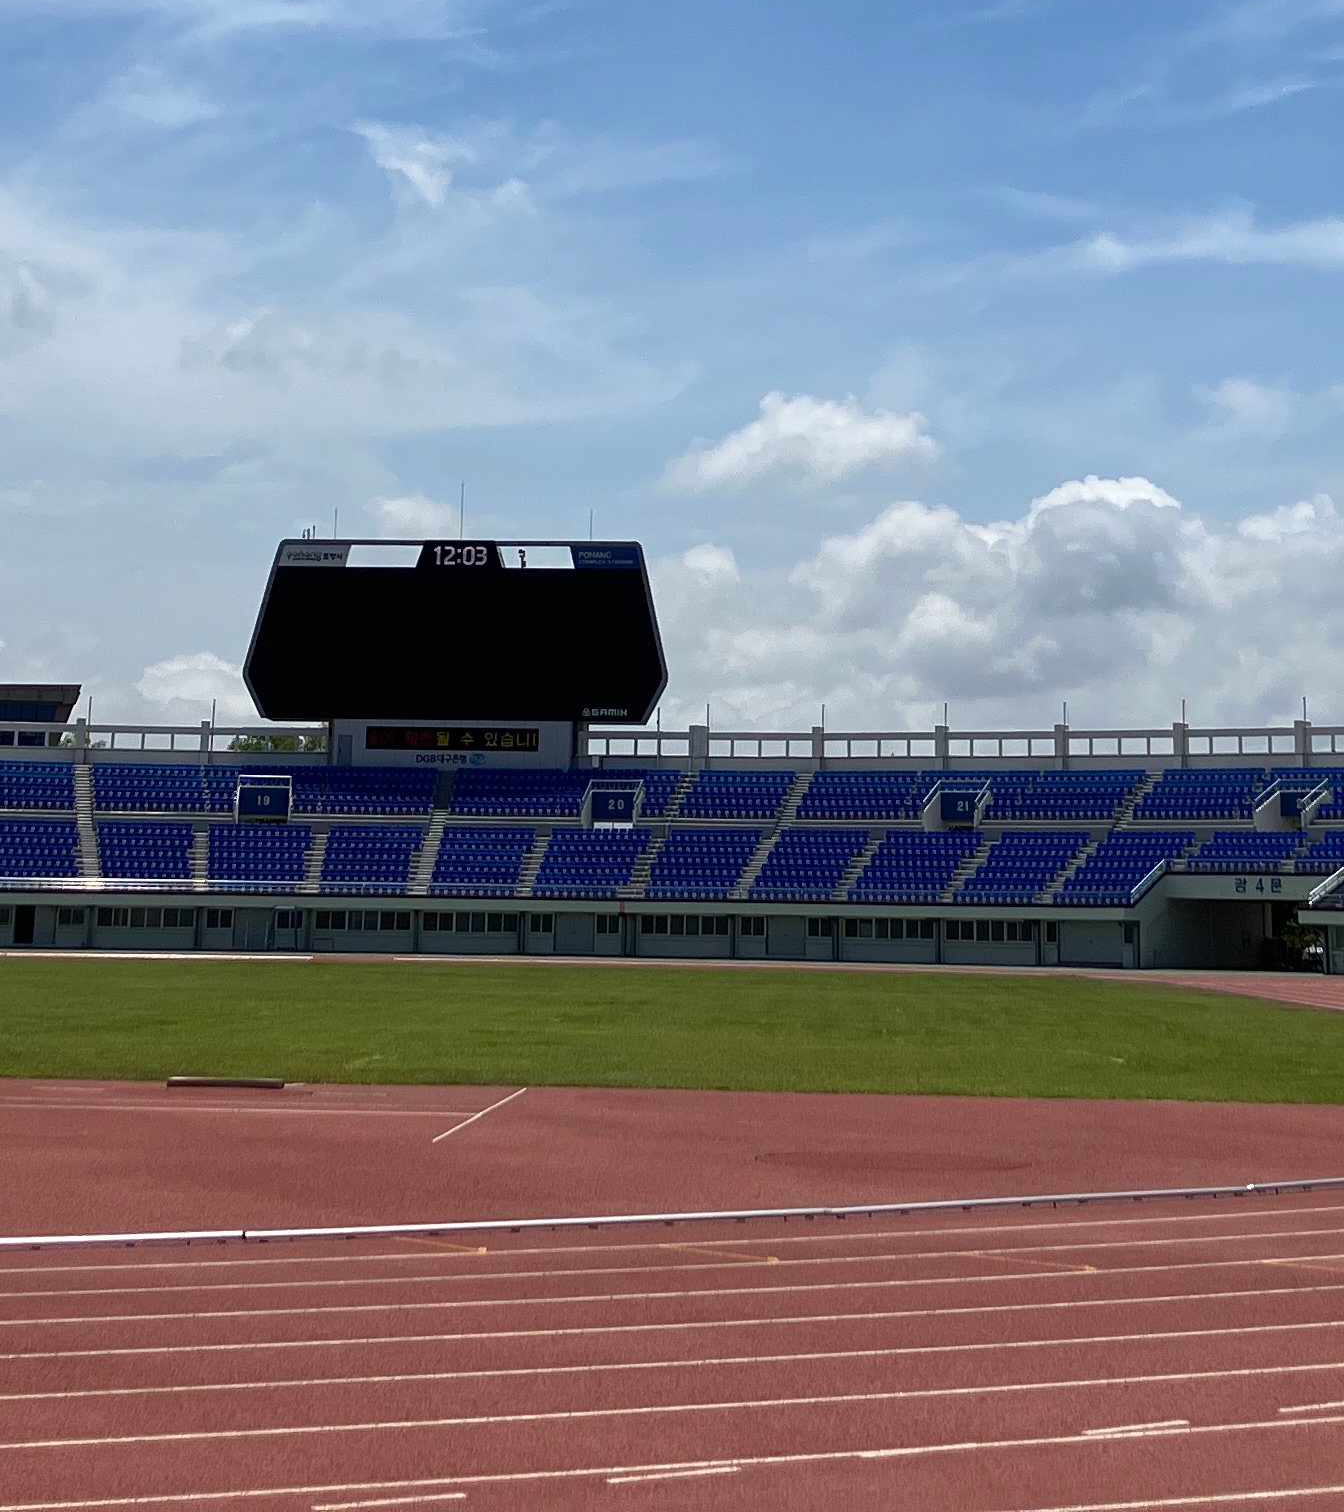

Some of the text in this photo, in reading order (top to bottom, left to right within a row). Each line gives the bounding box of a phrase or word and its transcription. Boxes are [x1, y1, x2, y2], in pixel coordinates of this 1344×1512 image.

[434, 546, 487, 565] 12:03
[578, 551, 612, 559] POHANG
[460, 732, 474, 747] 수
[484, 732, 537, 747] 있습니
[257, 795, 270, 806] 19
[608, 799, 625, 810] 20
[957, 800, 969, 812] 21
